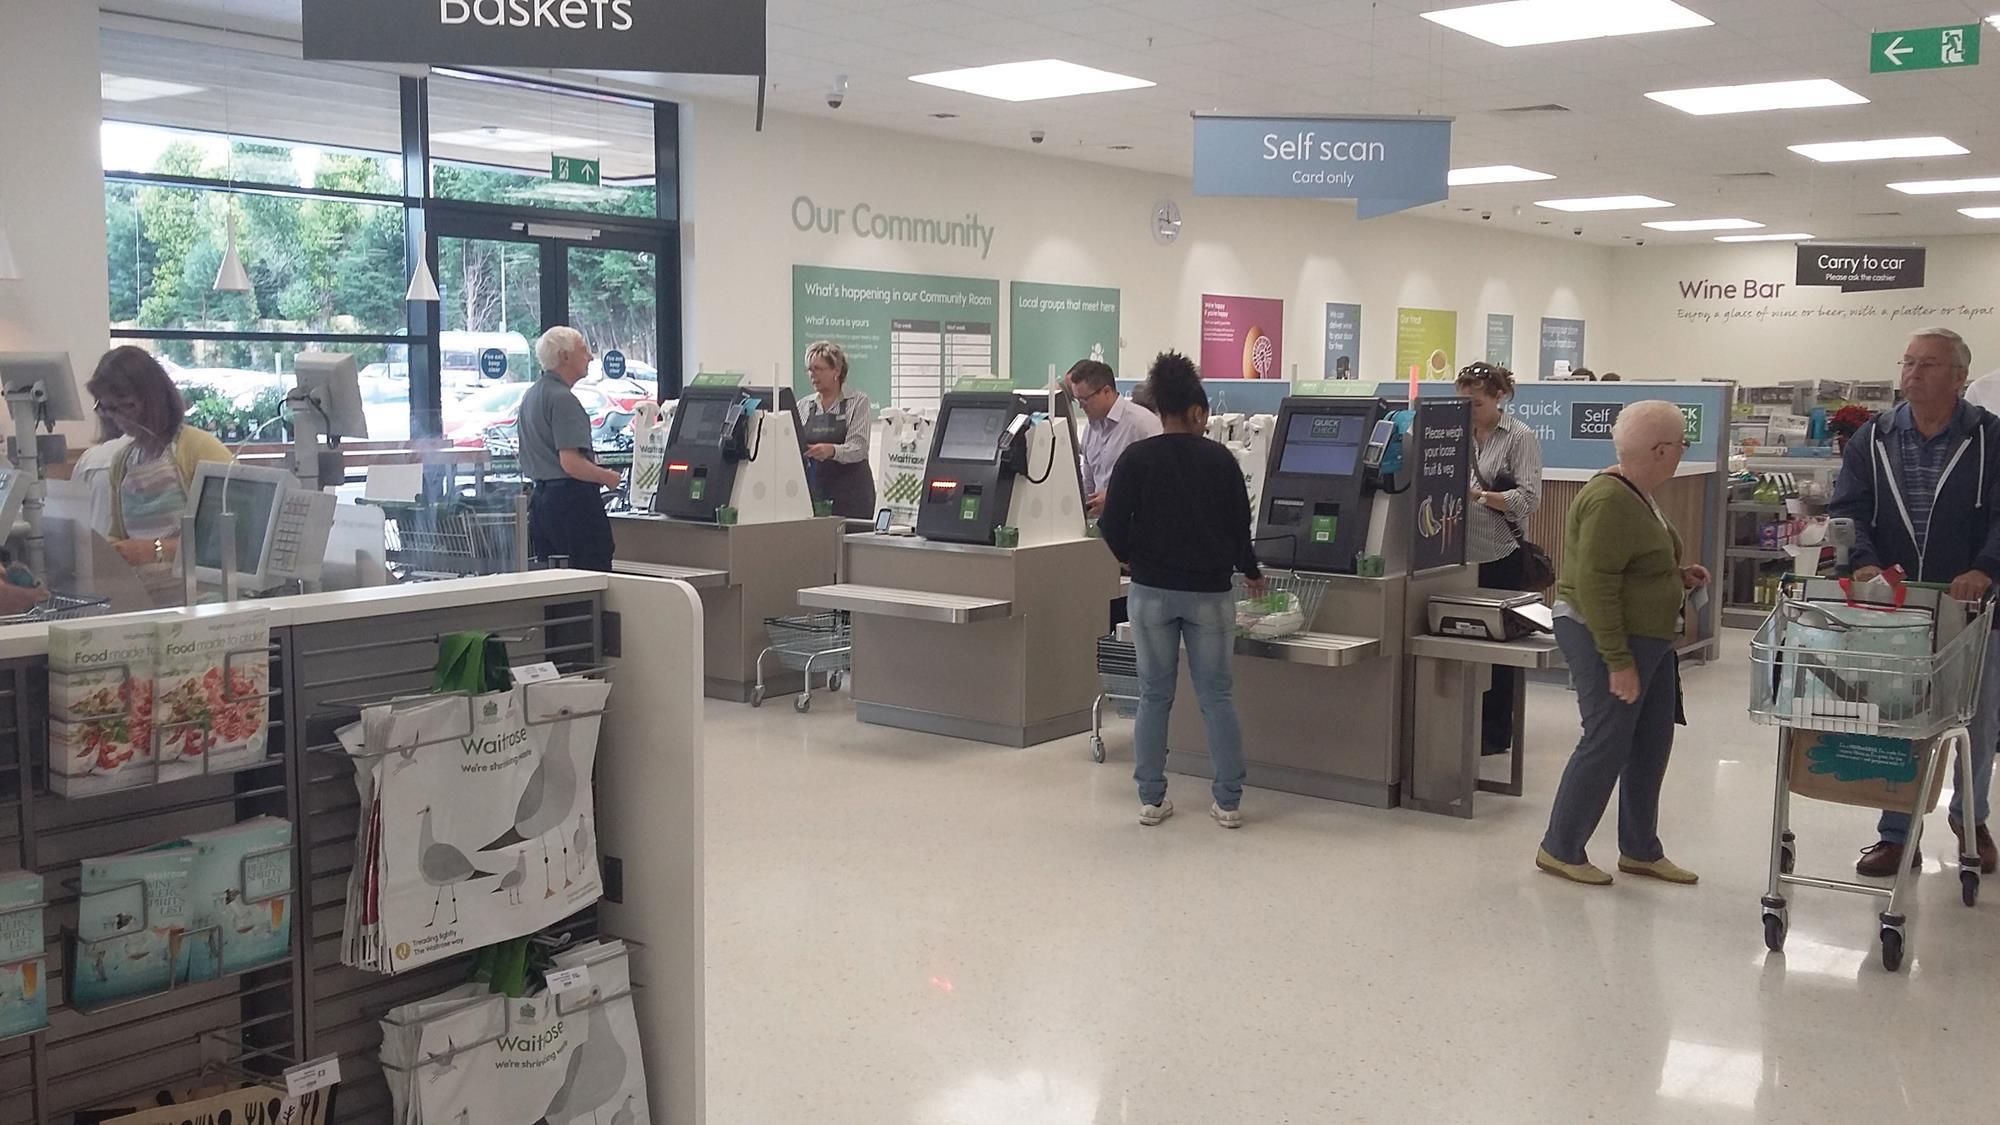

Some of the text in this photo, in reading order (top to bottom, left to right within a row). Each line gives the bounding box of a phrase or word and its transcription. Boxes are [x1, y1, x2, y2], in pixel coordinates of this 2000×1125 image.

[440, 0, 633, 31] Baskets
[1262, 132, 1385, 162] Self scan
[1292, 170, 1354, 188] Card only
[791, 195, 994, 261] Our Community
[1817, 254, 1906, 273] Carry to car
[1825, 272, 1896, 282] Please ask the cashier
[804, 281, 992, 308] What's happening in our Community Room
[1678, 278, 1786, 299] Wine Bar
[1018, 296, 1116, 313] Local groups that meet here
[1676, 307, 1711, 323] Enjoy
[1724, 307, 1753, 323] glass
[1755, 305, 1768, 322] of
[1771, 308, 1798, 318] wine
[1801, 309, 1814, 317] or
[1848, 304, 1876, 316] with
[1880, 308, 1888, 316] a
[1890, 303, 1937, 321] platter
[1940, 306, 1955, 315] or
[1958, 304, 1995, 320] tapas
[804, 315, 870, 329] What's ours is yours
[1519, 400, 1562, 420] quick
[1584, 408, 1611, 422] Self
[1314, 419, 1341, 427] QUICK
[1580, 422, 1613, 433] scan
[1424, 424, 1464, 442] Please weigh
[1533, 424, 1556, 441] ith
[1423, 444, 1457, 462] your loose
[1423, 462, 1437, 476] fruit
[1442, 464, 1455, 478] veg
[74, 648, 108, 665] Food
[166, 640, 196, 655] Food
[460, 728, 528, 756] Waitrose
[460, 762, 489, 773] We're
[412, 935, 439, 947] Treading
[413, 937, 465, 956] The Waitrose way
[496, 1020, 564, 1053] Waitose
[494, 1059, 520, 1069] We're
